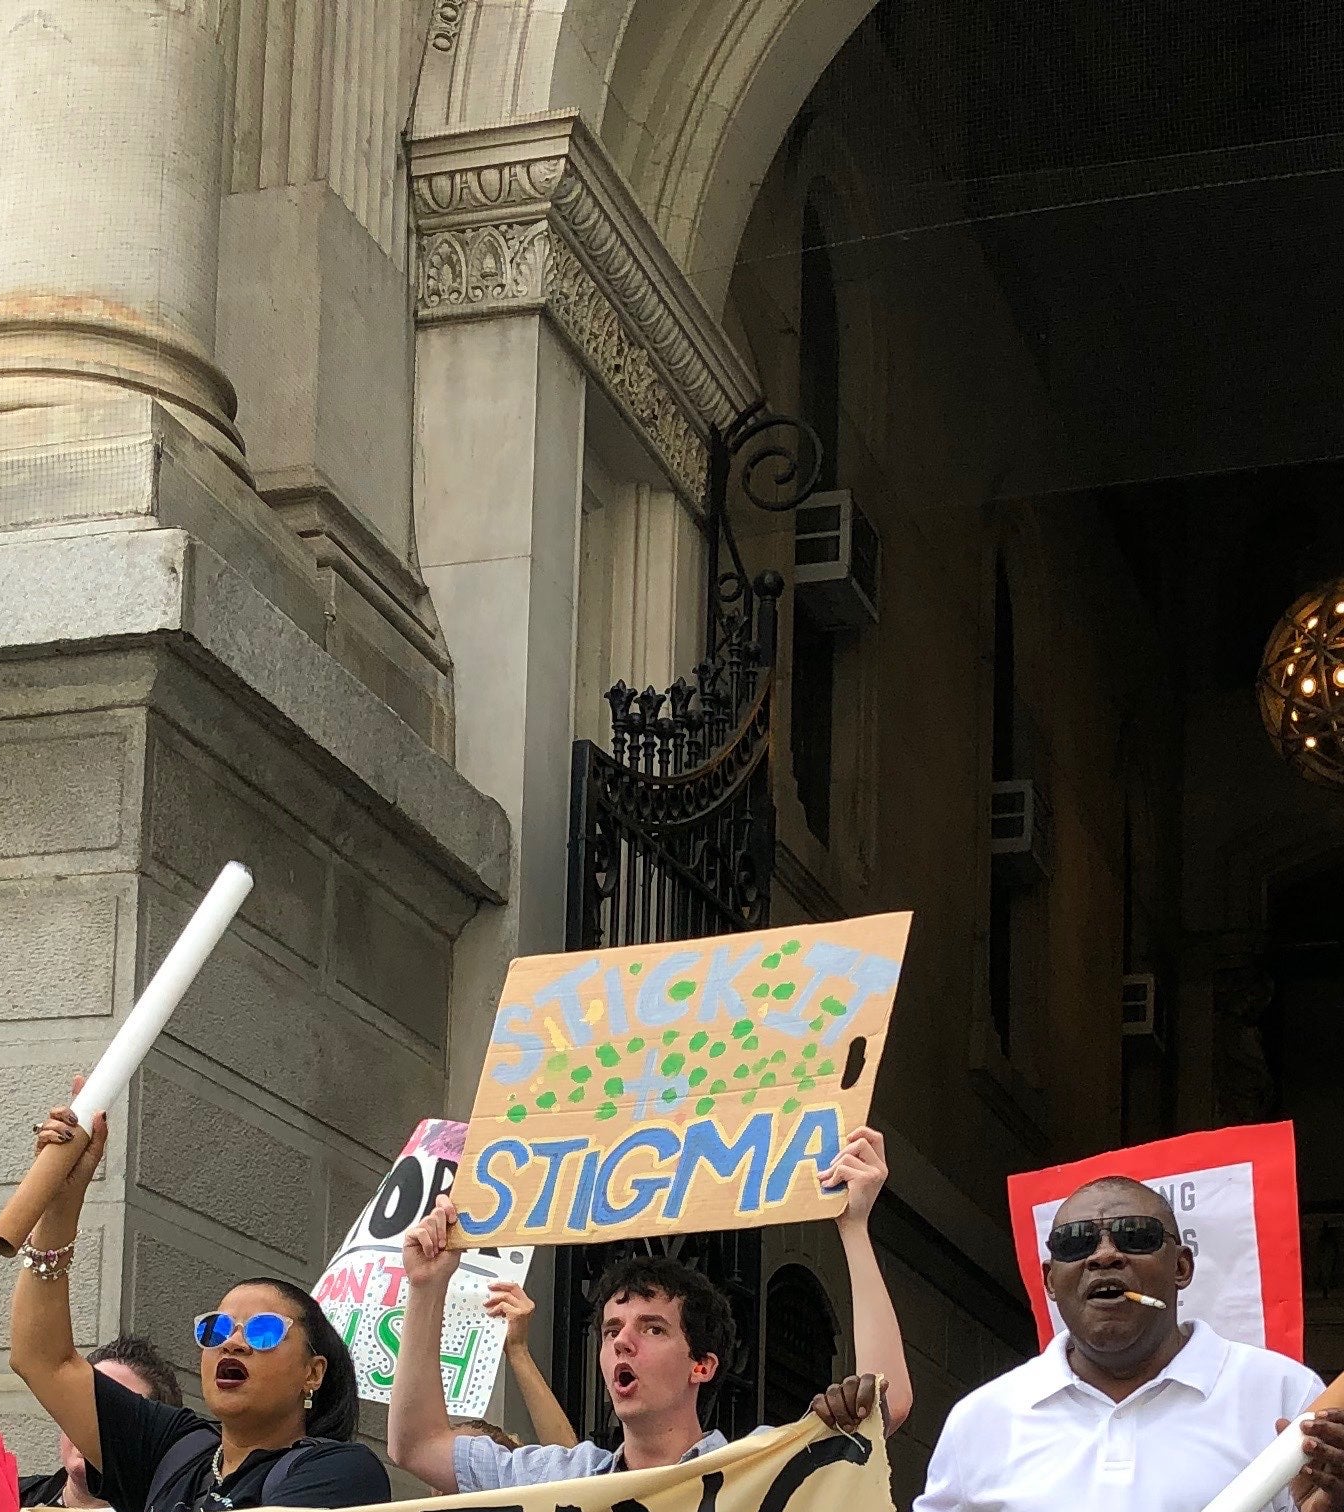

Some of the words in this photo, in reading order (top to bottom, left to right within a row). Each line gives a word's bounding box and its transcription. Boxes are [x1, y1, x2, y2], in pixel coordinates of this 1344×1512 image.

[490, 942, 763, 1086] STICK
[762, 940, 903, 1048] IT
[622, 1047, 691, 1122] to
[456, 1103, 850, 1238] STIGMA
